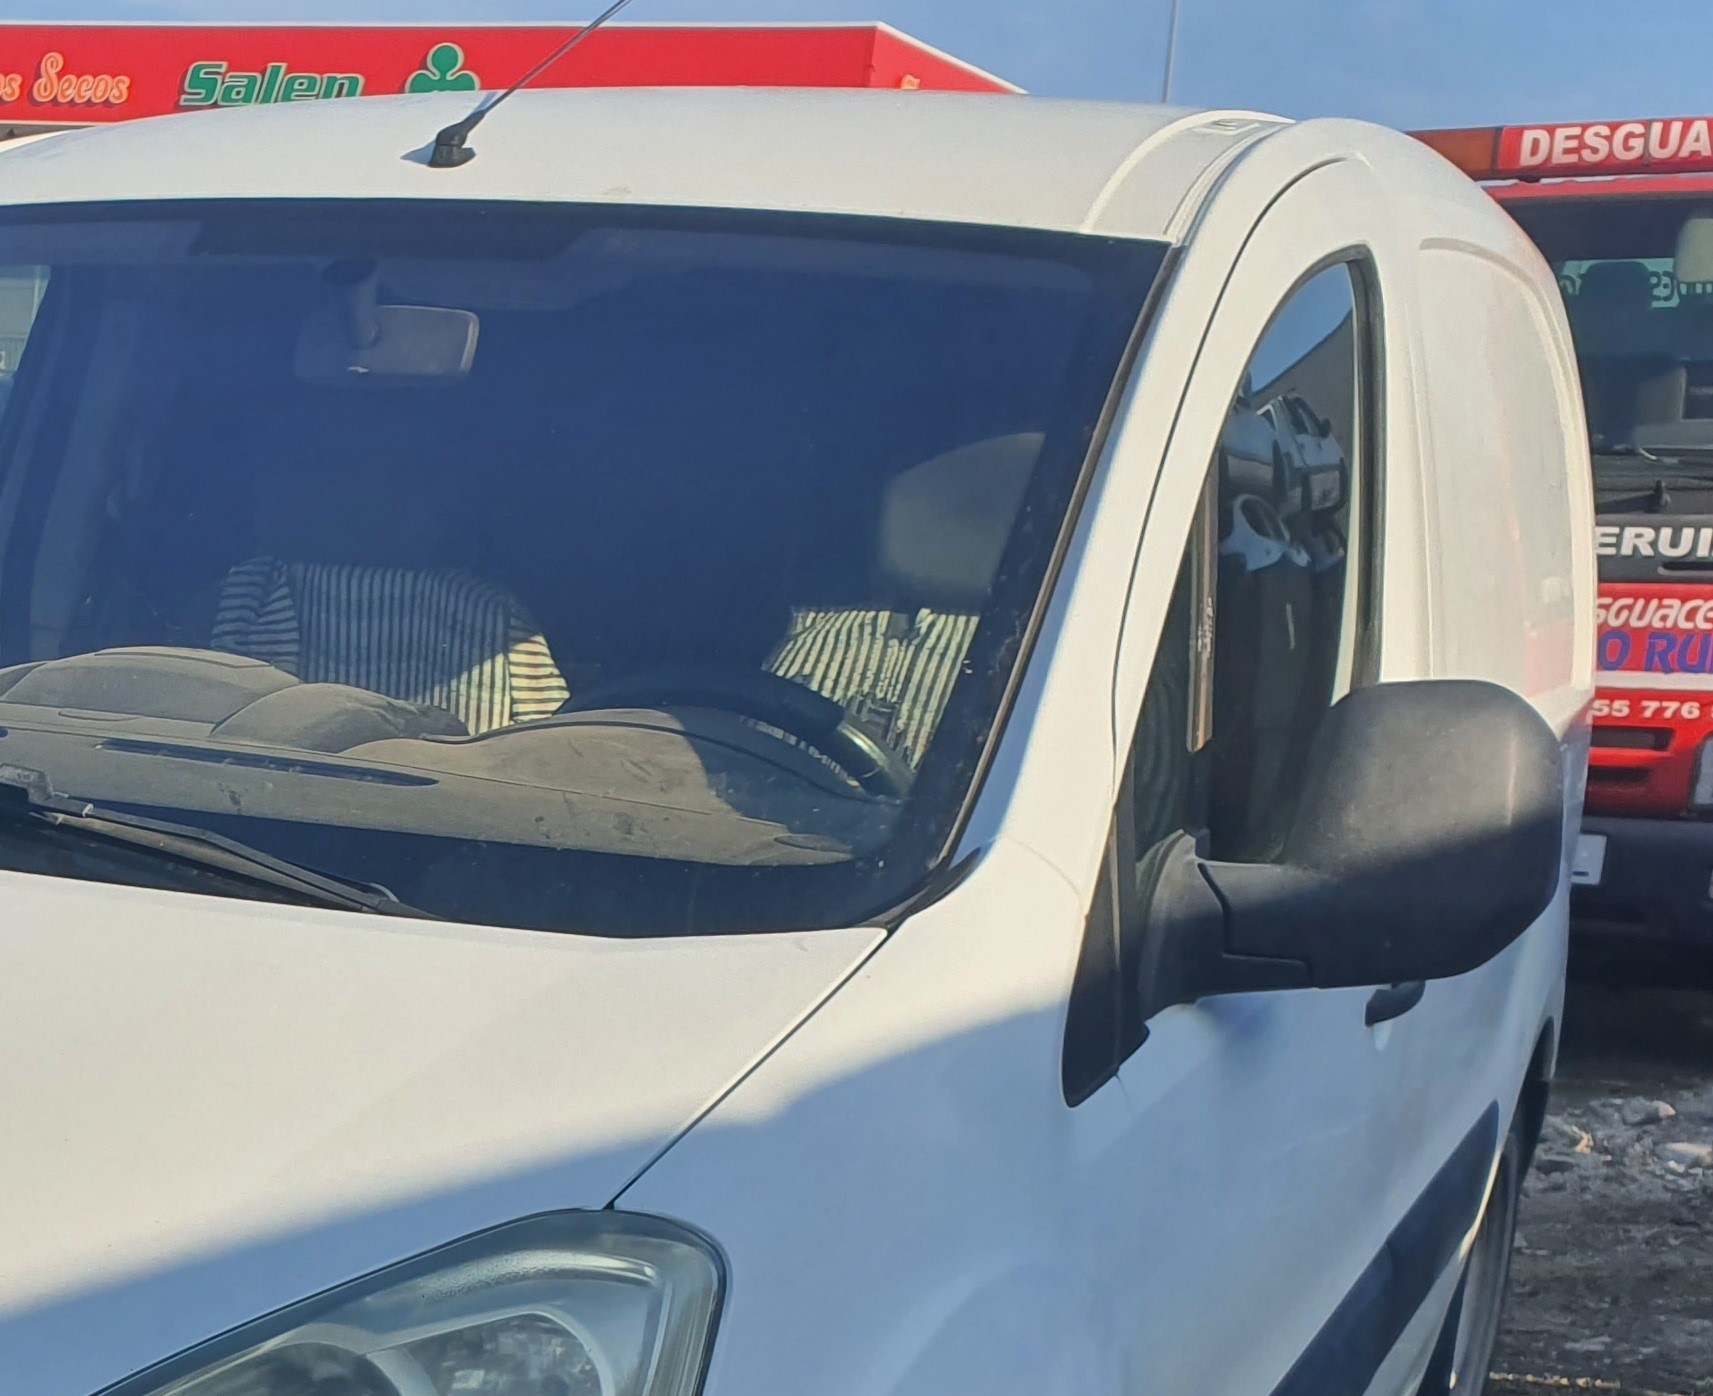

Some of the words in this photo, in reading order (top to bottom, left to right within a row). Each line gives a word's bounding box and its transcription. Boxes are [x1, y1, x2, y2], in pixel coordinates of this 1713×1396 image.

[32, 51, 131, 104] Secos
[179, 61, 364, 106] Salen
[1641, 700, 1701, 719] 776
